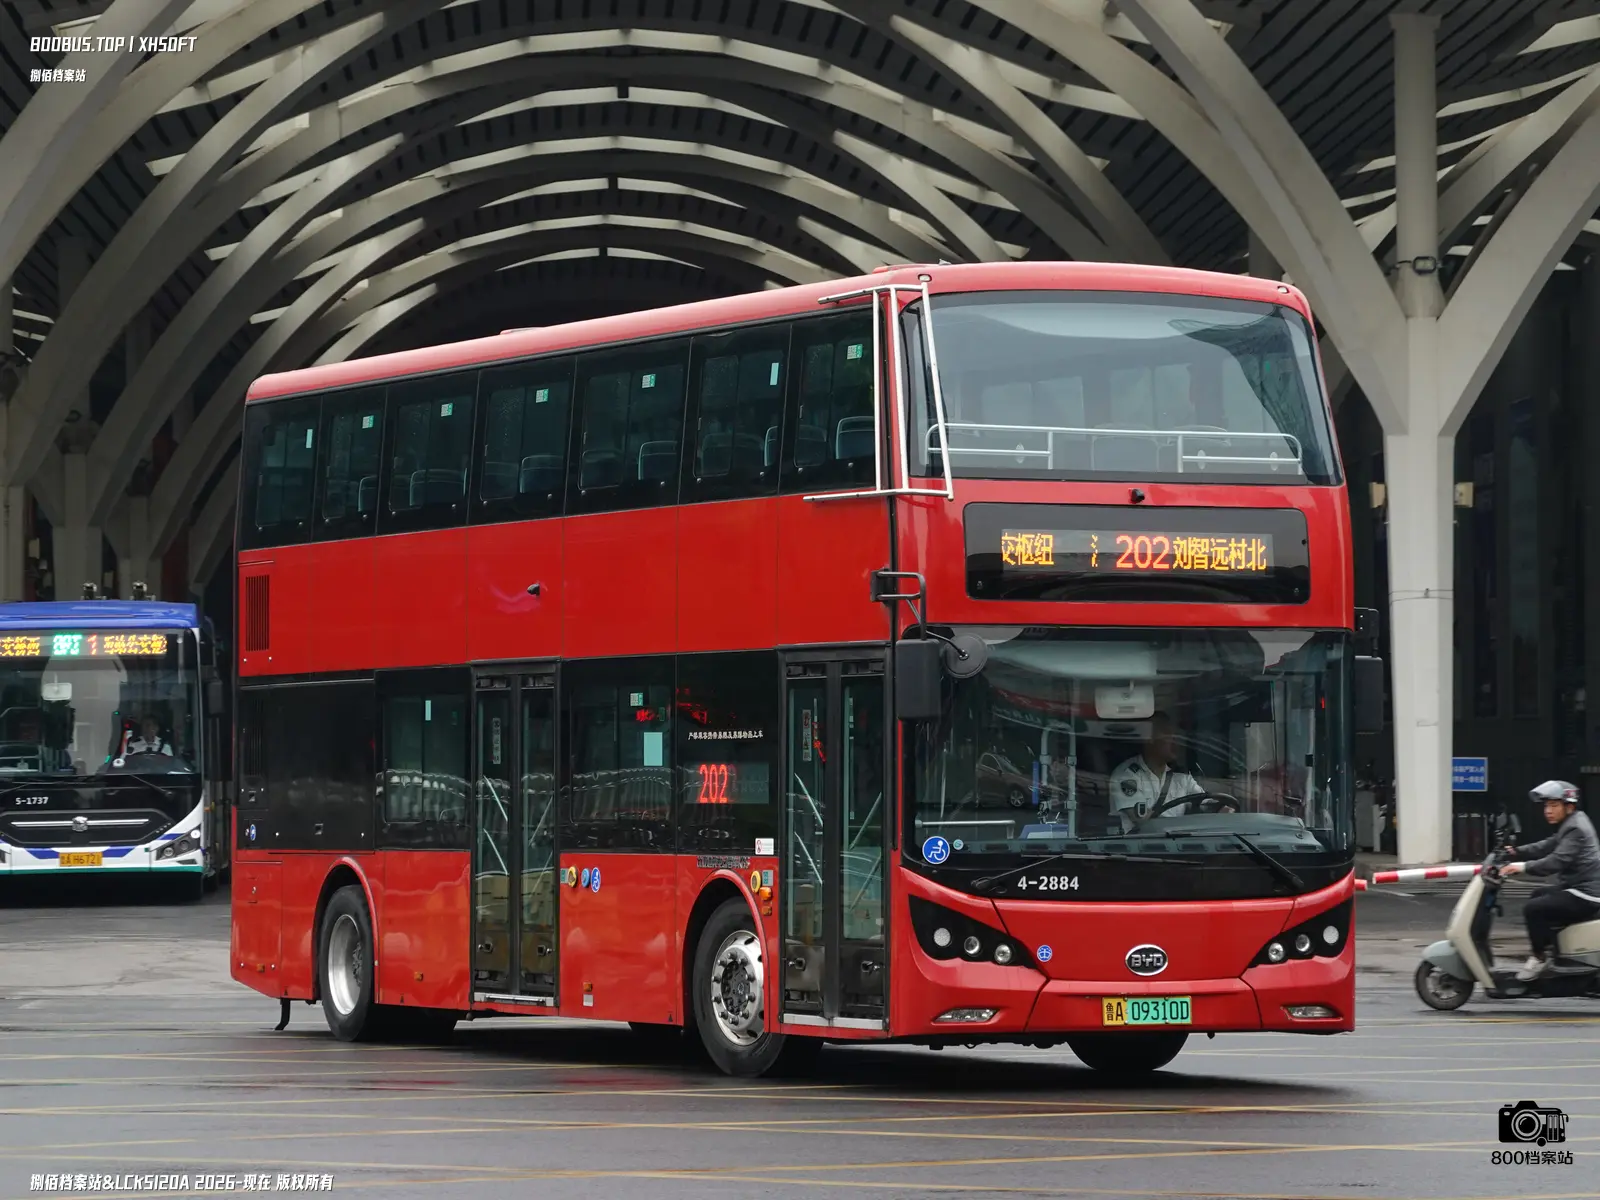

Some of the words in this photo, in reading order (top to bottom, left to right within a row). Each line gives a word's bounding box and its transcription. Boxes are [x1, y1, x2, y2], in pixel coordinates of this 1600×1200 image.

[1115, 534, 1171, 569] 202
[1172, 536, 1267, 571] 刘智远村北
[699, 763, 729, 804] 202
[1017, 875, 1080, 891] 4-2884
[1131, 953, 1164, 967] BYD
